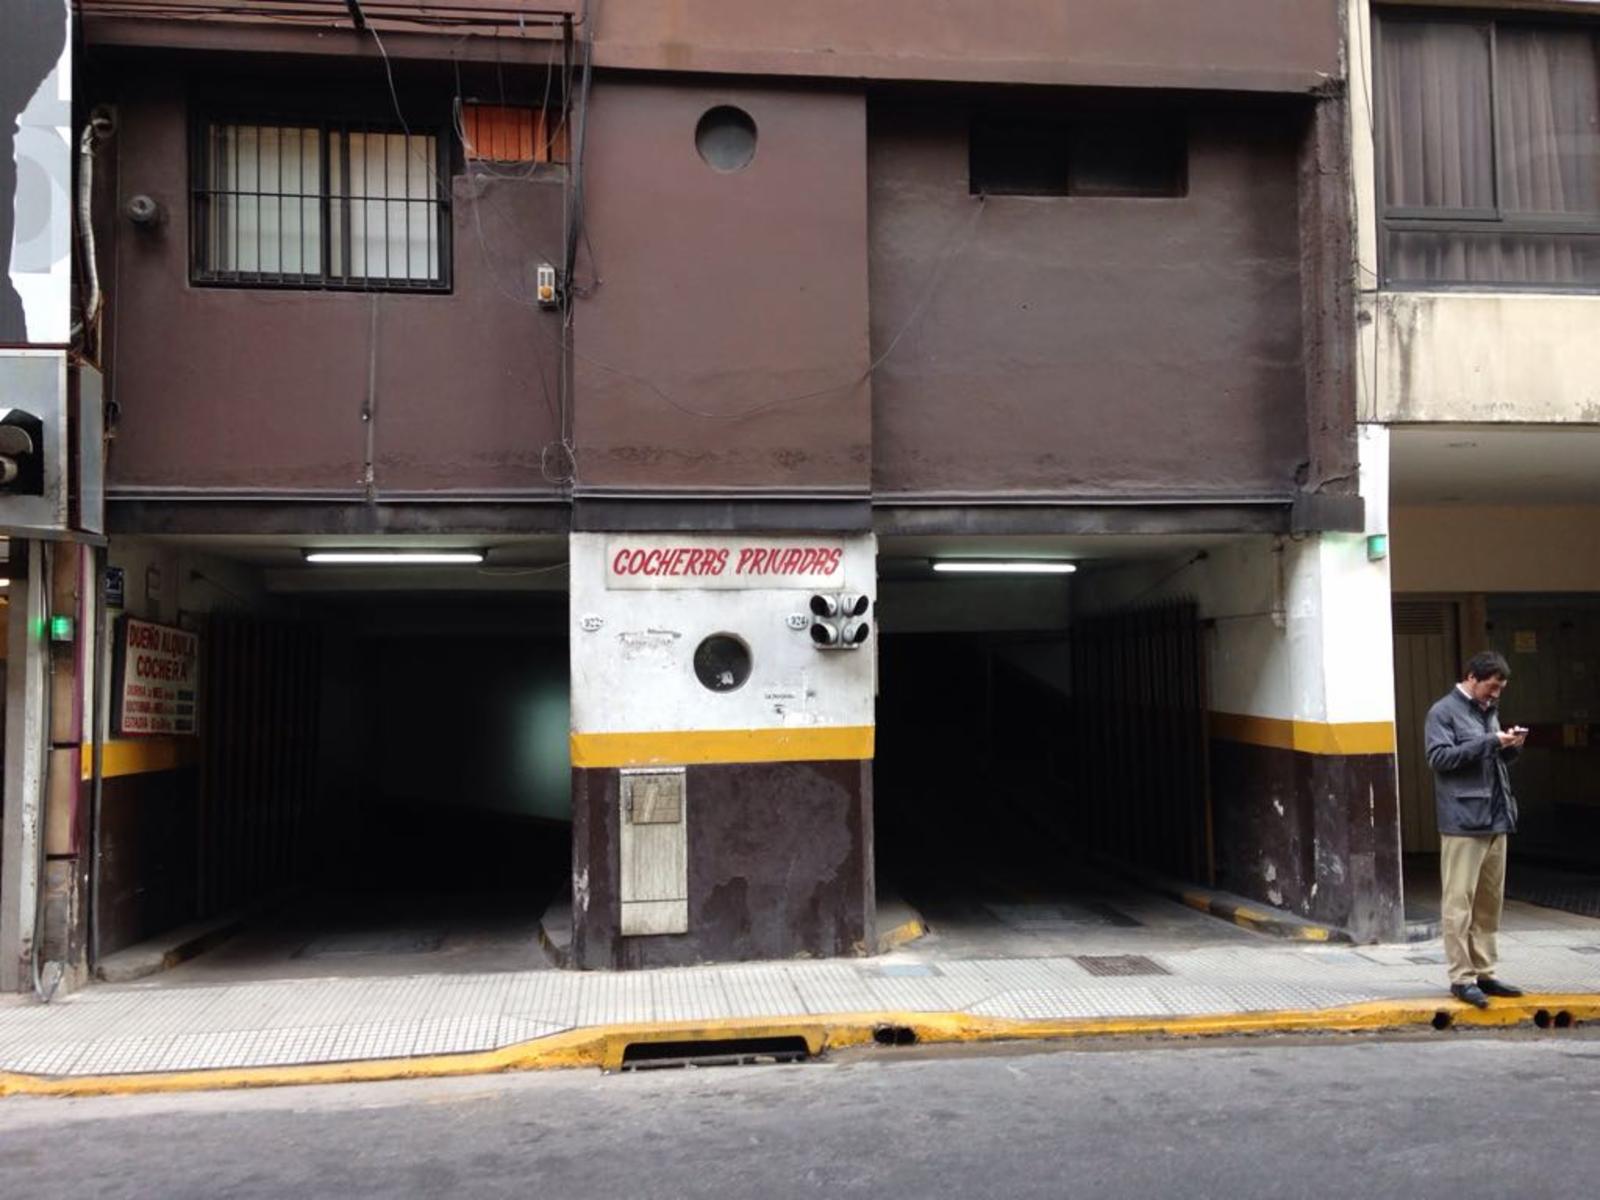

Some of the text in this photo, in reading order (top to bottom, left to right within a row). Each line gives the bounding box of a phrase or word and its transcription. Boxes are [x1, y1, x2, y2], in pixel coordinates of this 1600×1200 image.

[613, 547, 843, 576] COCHERAS PRIVADAS
[129, 624, 160, 651] DUEÑO
[136, 655, 188, 682] COCHERA
